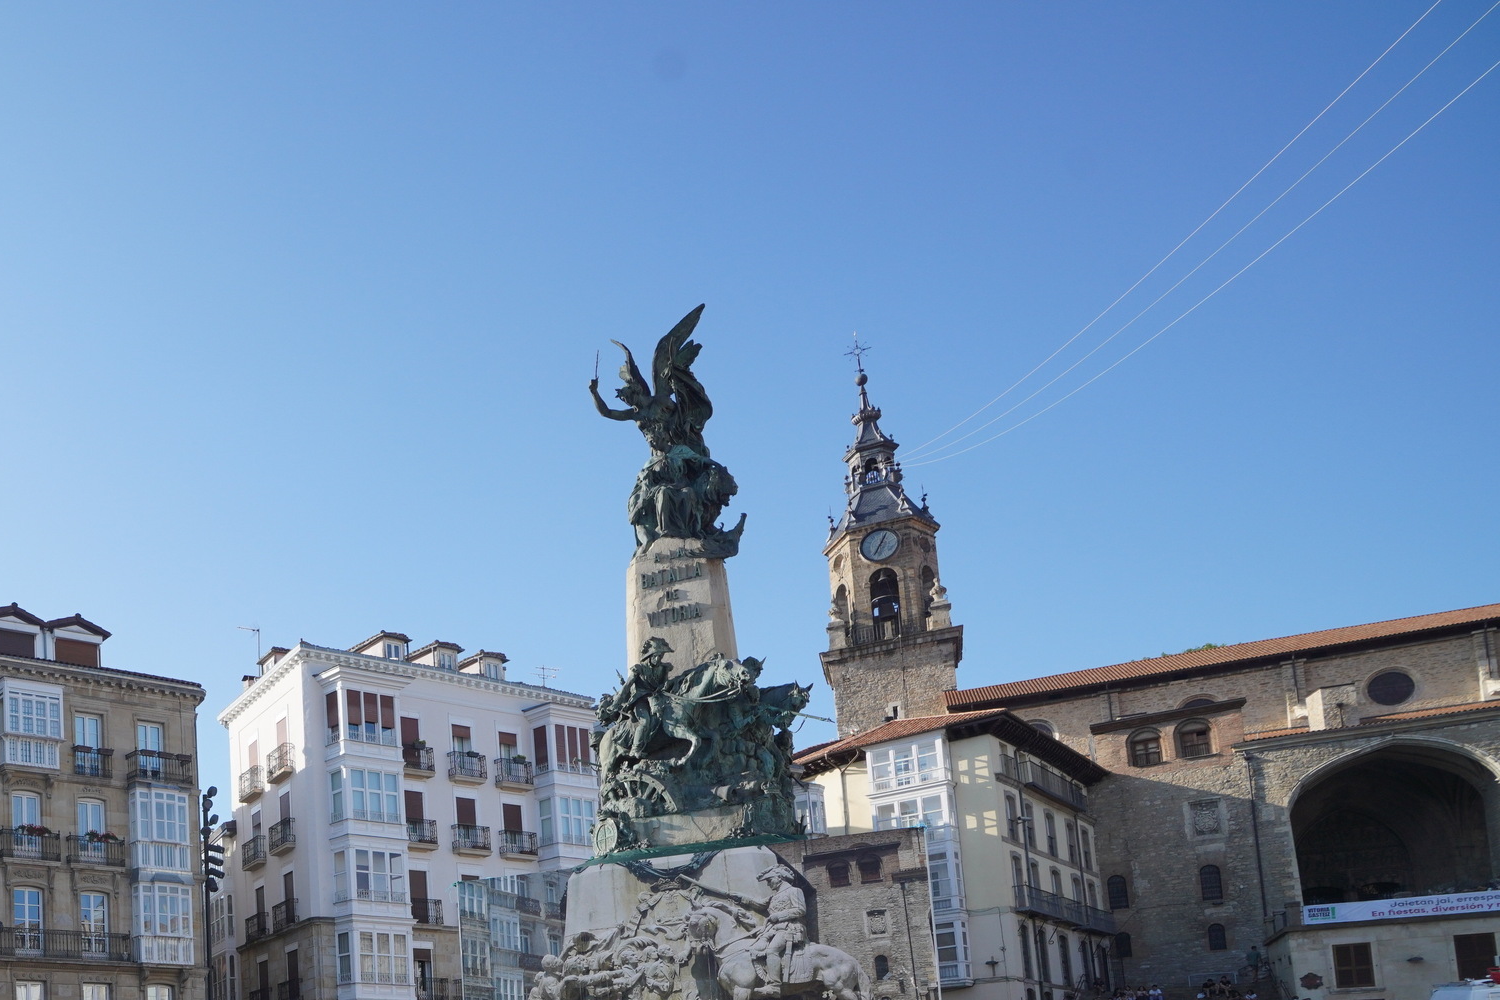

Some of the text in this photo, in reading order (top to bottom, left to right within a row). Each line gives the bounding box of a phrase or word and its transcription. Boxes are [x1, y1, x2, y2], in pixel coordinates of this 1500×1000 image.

[641, 562, 701, 589] BATALLA
[666, 589, 680, 601] DE
[647, 602, 701, 628] VITORIA
[1371, 910, 1385, 918] En
[1388, 907, 1429, 917] fiestas,
[1431, 902, 1484, 913] diversión
[1390, 898, 1434, 908] Jaietan
